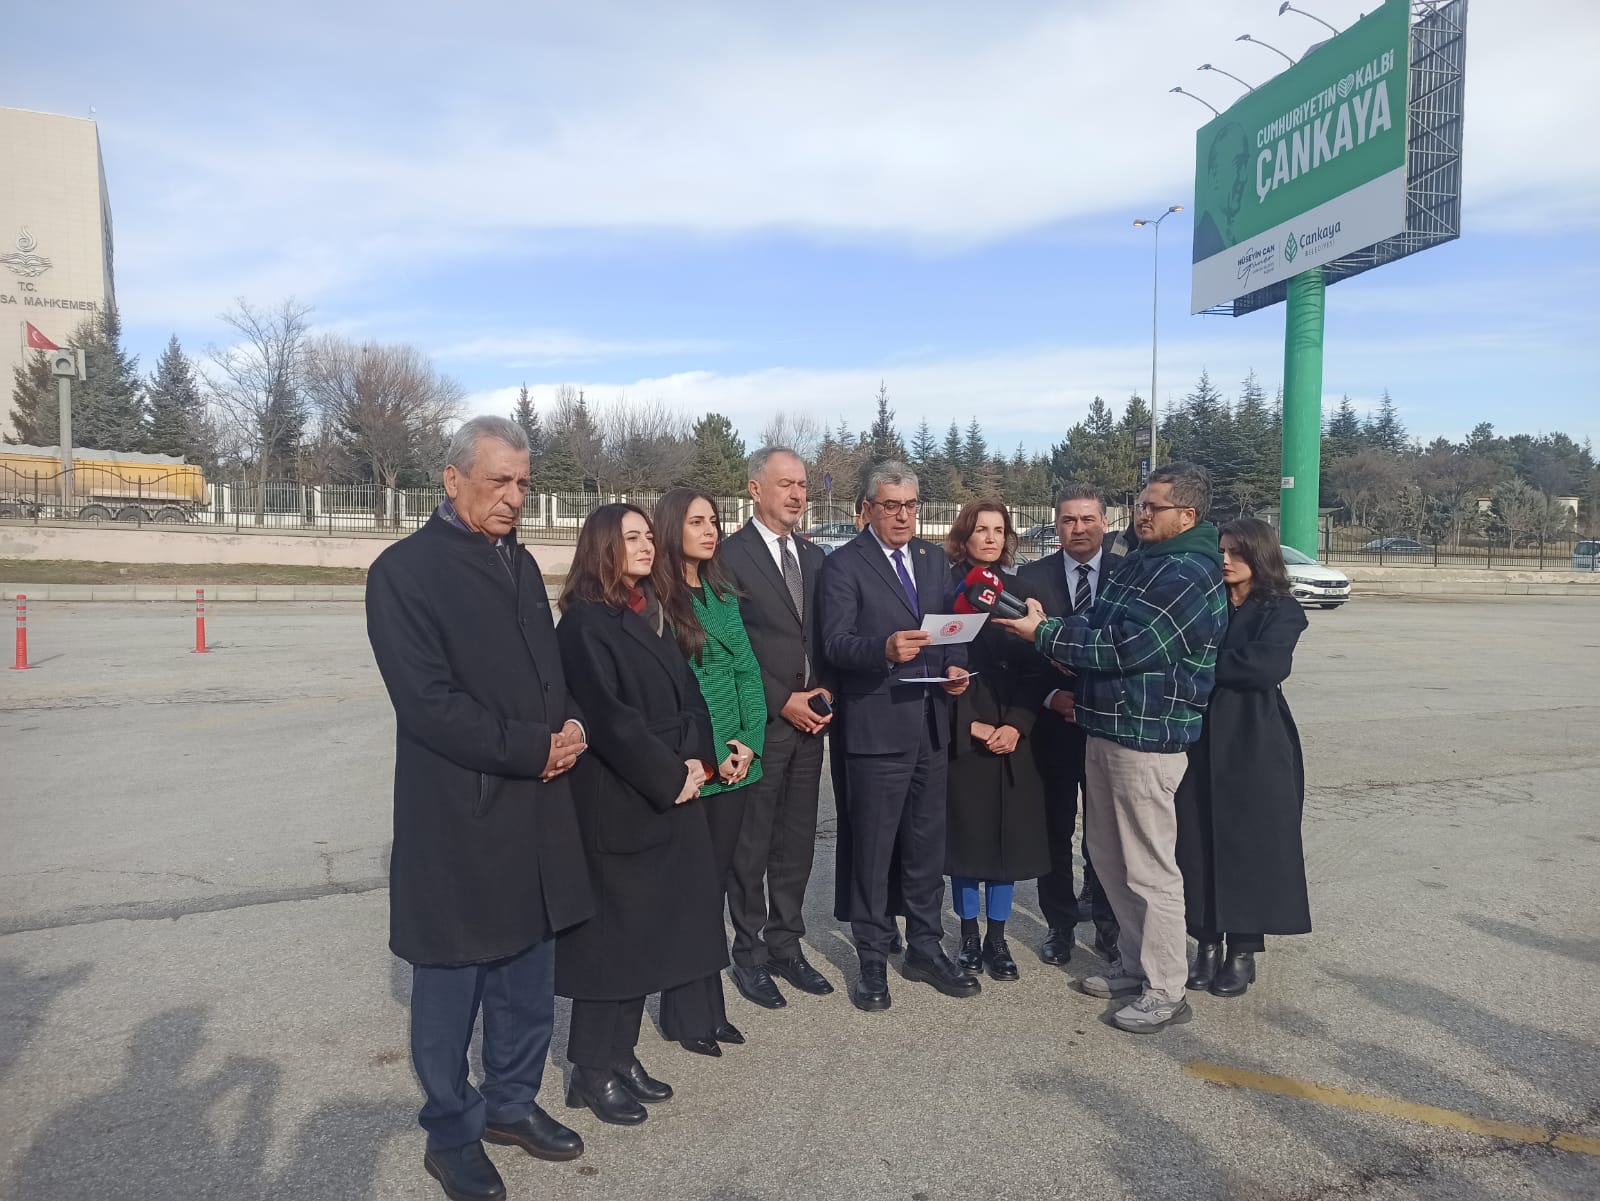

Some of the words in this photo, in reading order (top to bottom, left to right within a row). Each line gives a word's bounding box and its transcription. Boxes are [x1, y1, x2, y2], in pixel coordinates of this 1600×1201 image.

[1257, 83, 1337, 148] CUMHURİYETİN
[1355, 48, 1394, 90] KALBİ
[1256, 79, 1392, 204] ÇANKAYA
[1263, 244, 1275, 256] CAN
[17, 281, 38, 292] T.C.
